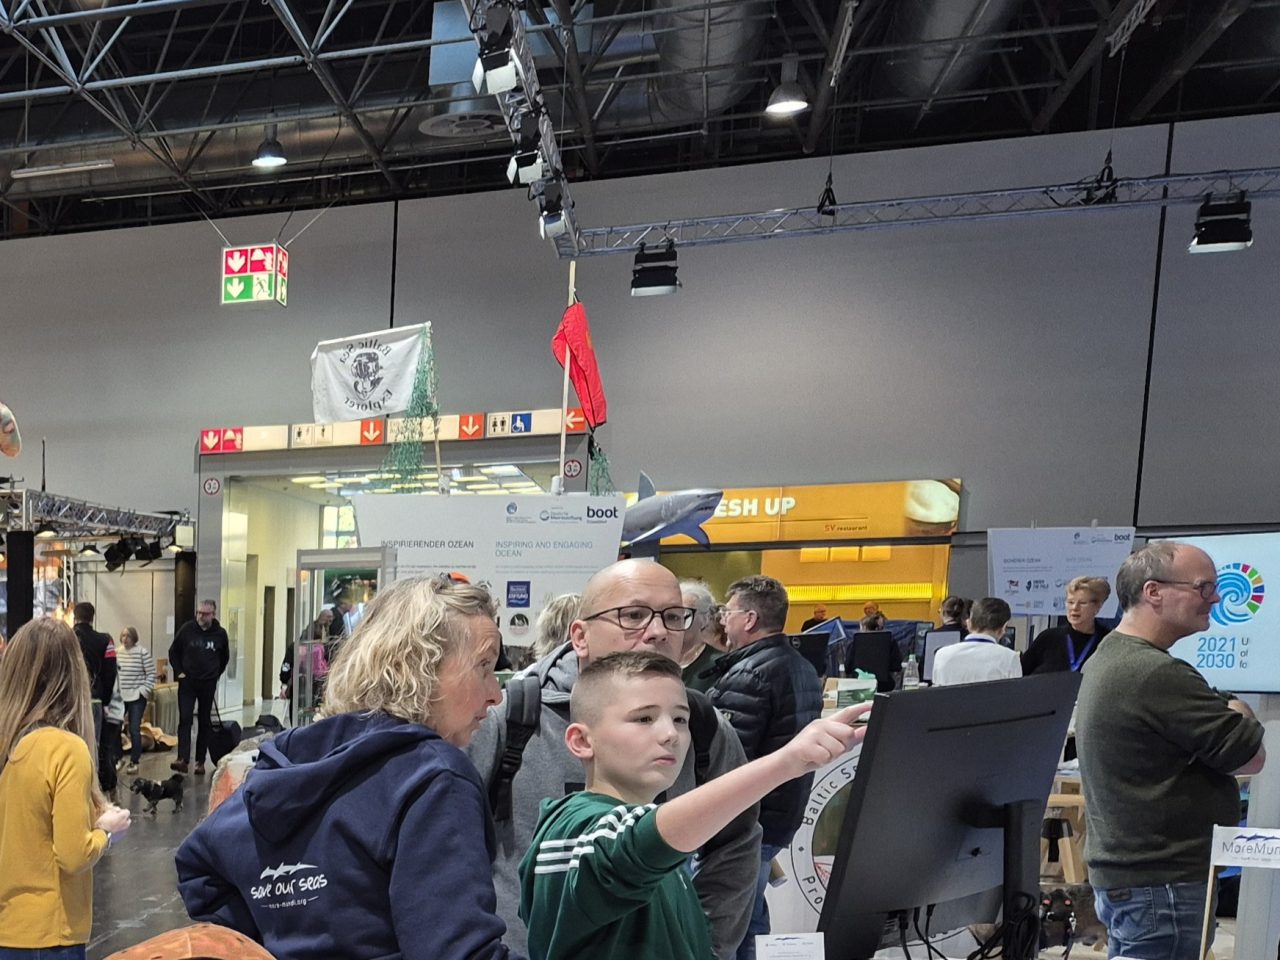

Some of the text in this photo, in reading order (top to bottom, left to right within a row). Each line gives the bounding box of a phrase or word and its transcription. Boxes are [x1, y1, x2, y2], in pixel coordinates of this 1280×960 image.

[587, 506, 618, 519] boot
[764, 497, 796, 515] UP
[381, 540, 474, 549] INSPIRIERENDER OZEAN
[495, 541, 593, 549] INSPIRING AND ENGAGING
[1197, 637, 1236, 652] 2021
[1196, 653, 1235, 669] 2030
[802, 780, 839, 827] Baltic
[250, 873, 328, 900] save our seas
